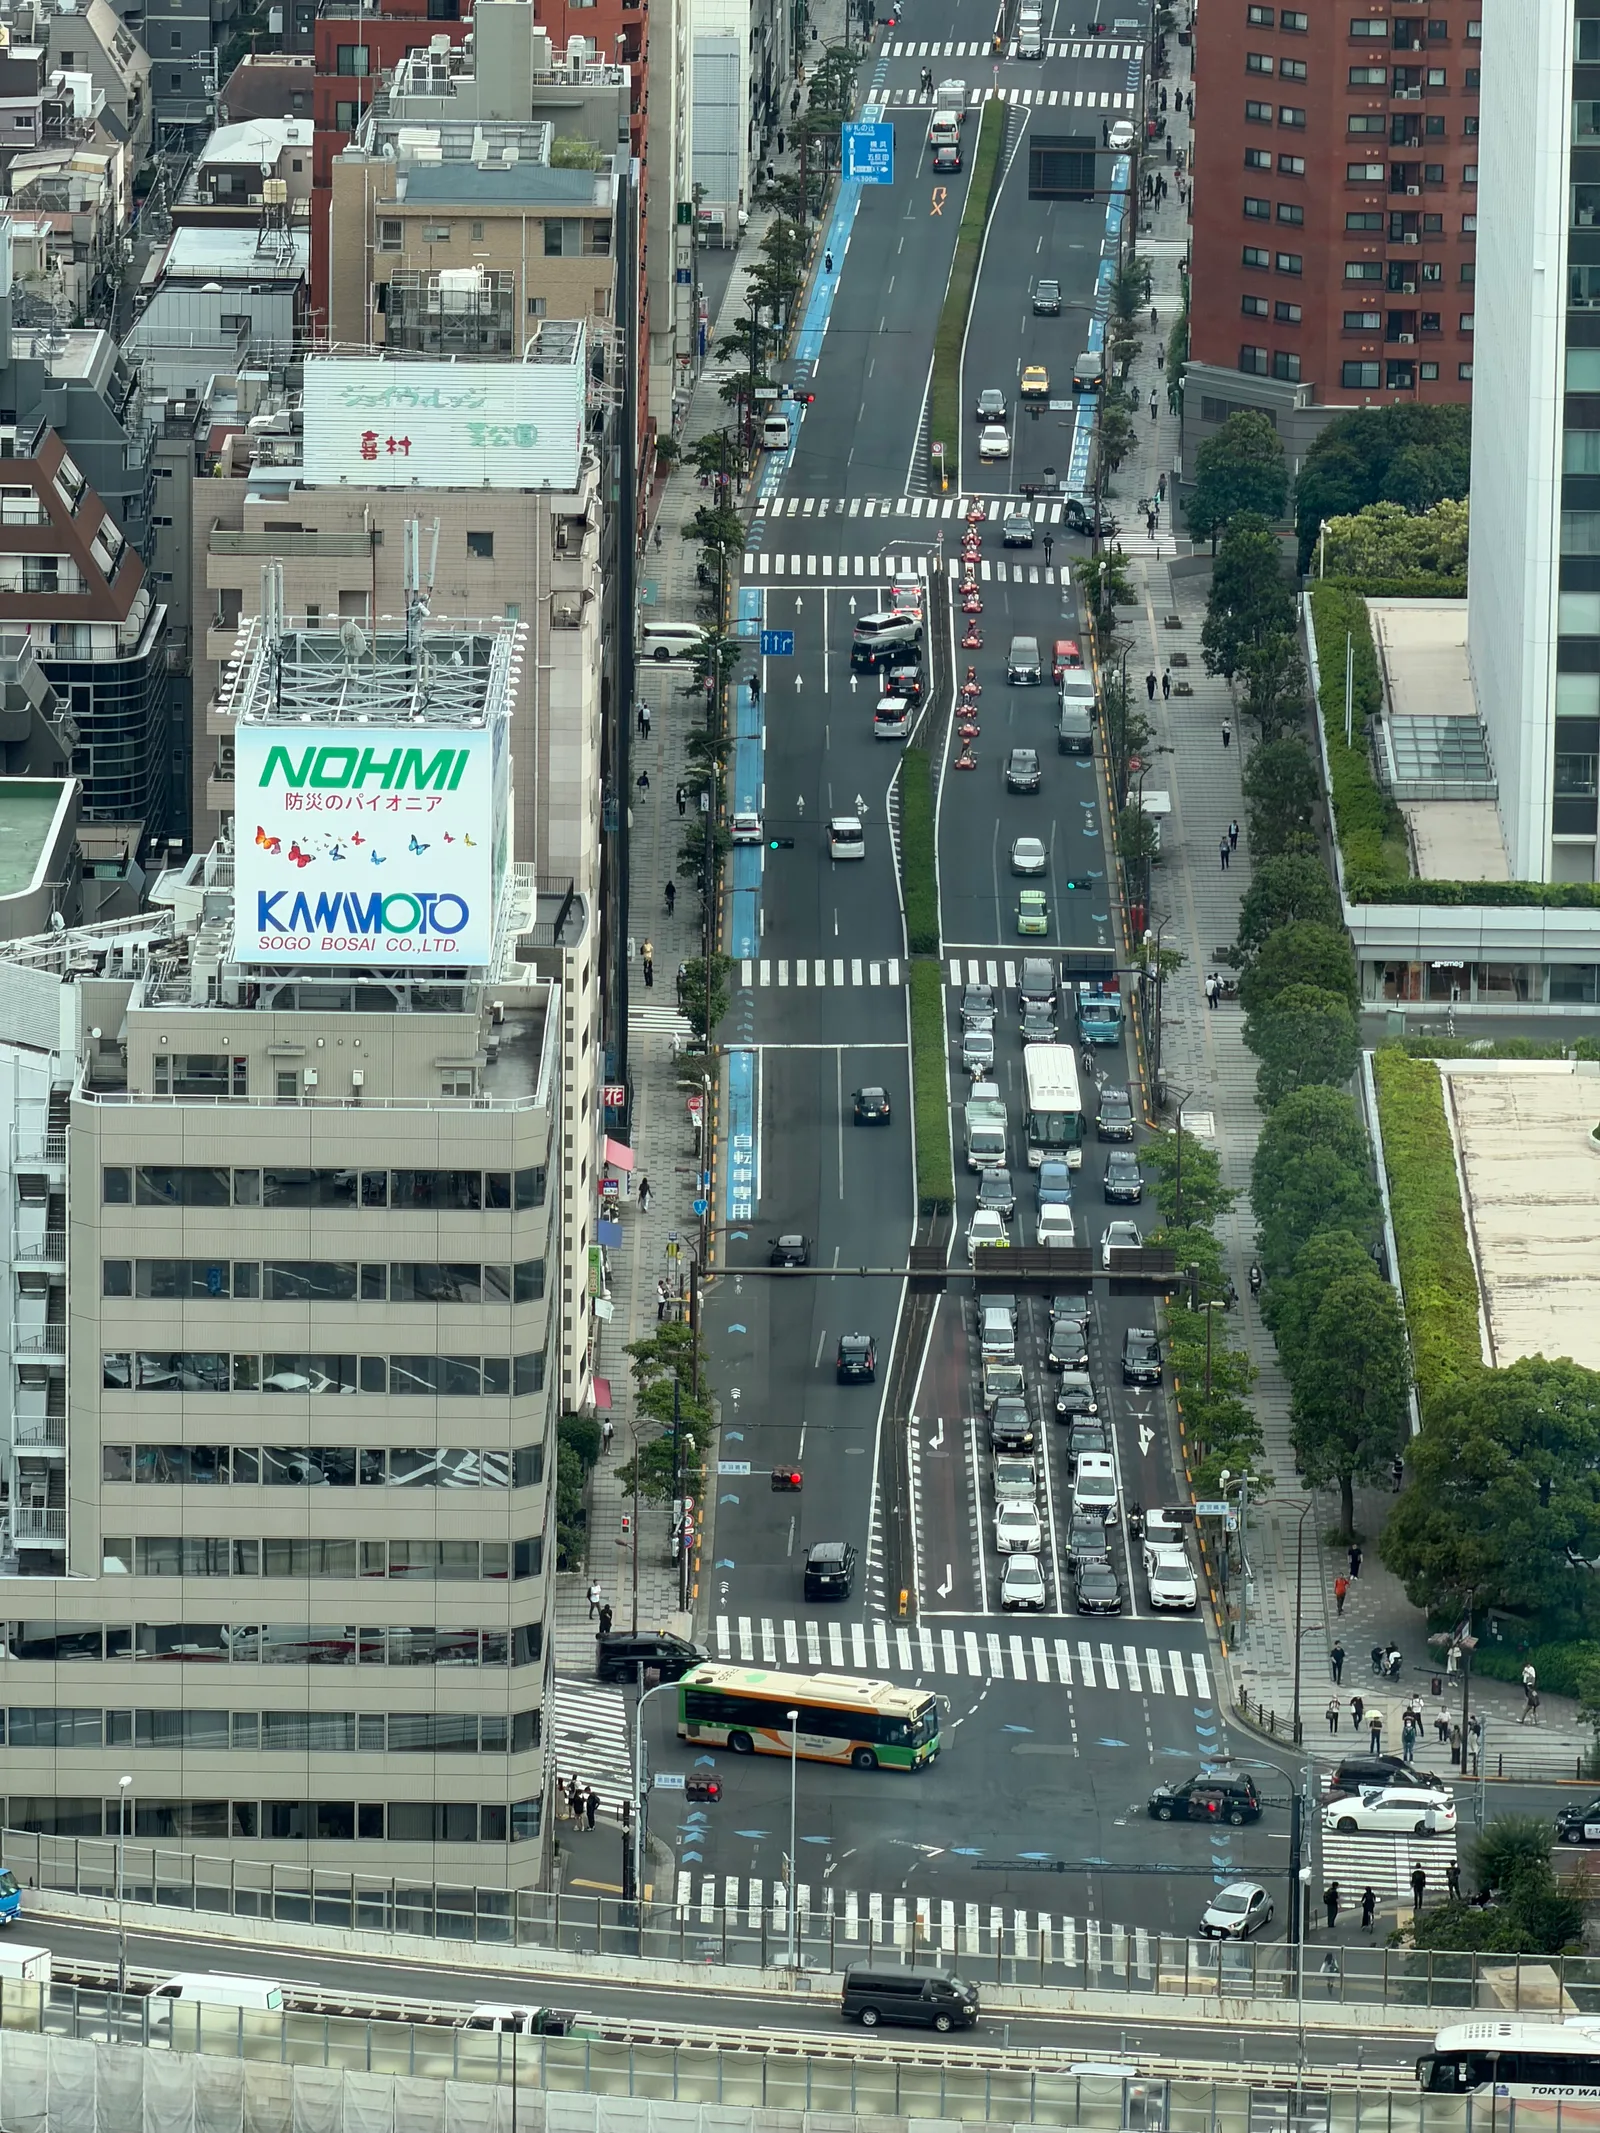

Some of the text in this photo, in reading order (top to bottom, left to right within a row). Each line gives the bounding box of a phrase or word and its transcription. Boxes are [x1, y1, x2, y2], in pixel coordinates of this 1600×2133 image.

[359, 430, 413, 461] 喜村
[465, 422, 538, 448] 芝公園
[258, 745, 471, 791] NOHMI
[285, 792, 443, 812] 防災のパイオニア
[258, 936, 460, 954] SOGO BOSAI CO.,LTD.
[605, 1087, 623, 1105] 花
[732, 1133, 753, 1220] 自転車専用
[1531, 2086, 1575, 2096] TOKYO
